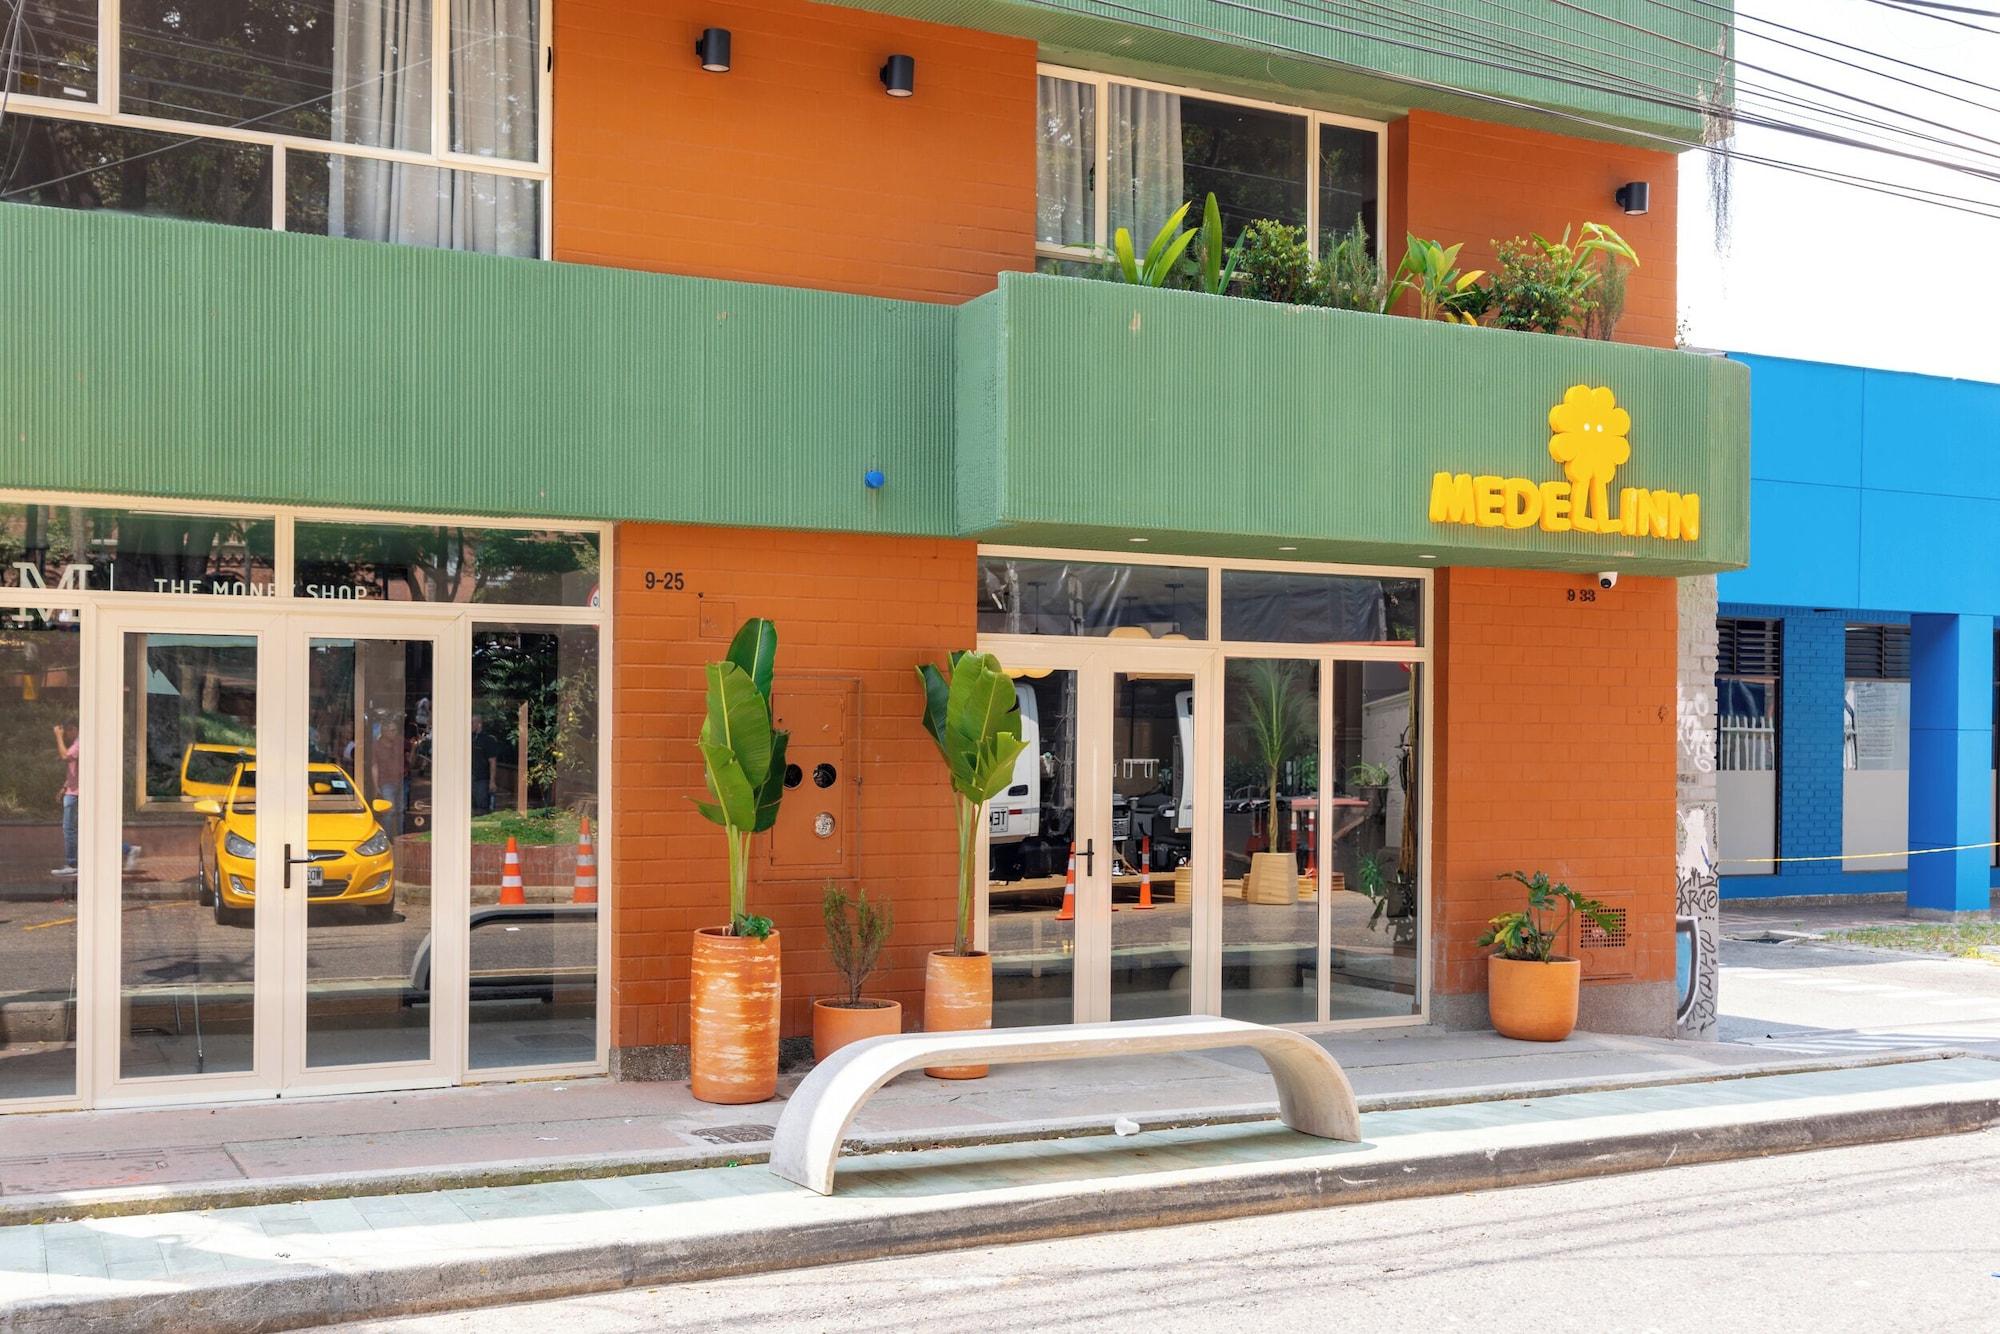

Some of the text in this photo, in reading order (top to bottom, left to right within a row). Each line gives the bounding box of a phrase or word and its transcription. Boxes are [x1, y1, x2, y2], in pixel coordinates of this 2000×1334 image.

[1429, 471, 1699, 541] MEDELLINN
[153, 578, 368, 600] THE MONE SHOP
[645, 571, 684, 590] 9-25
